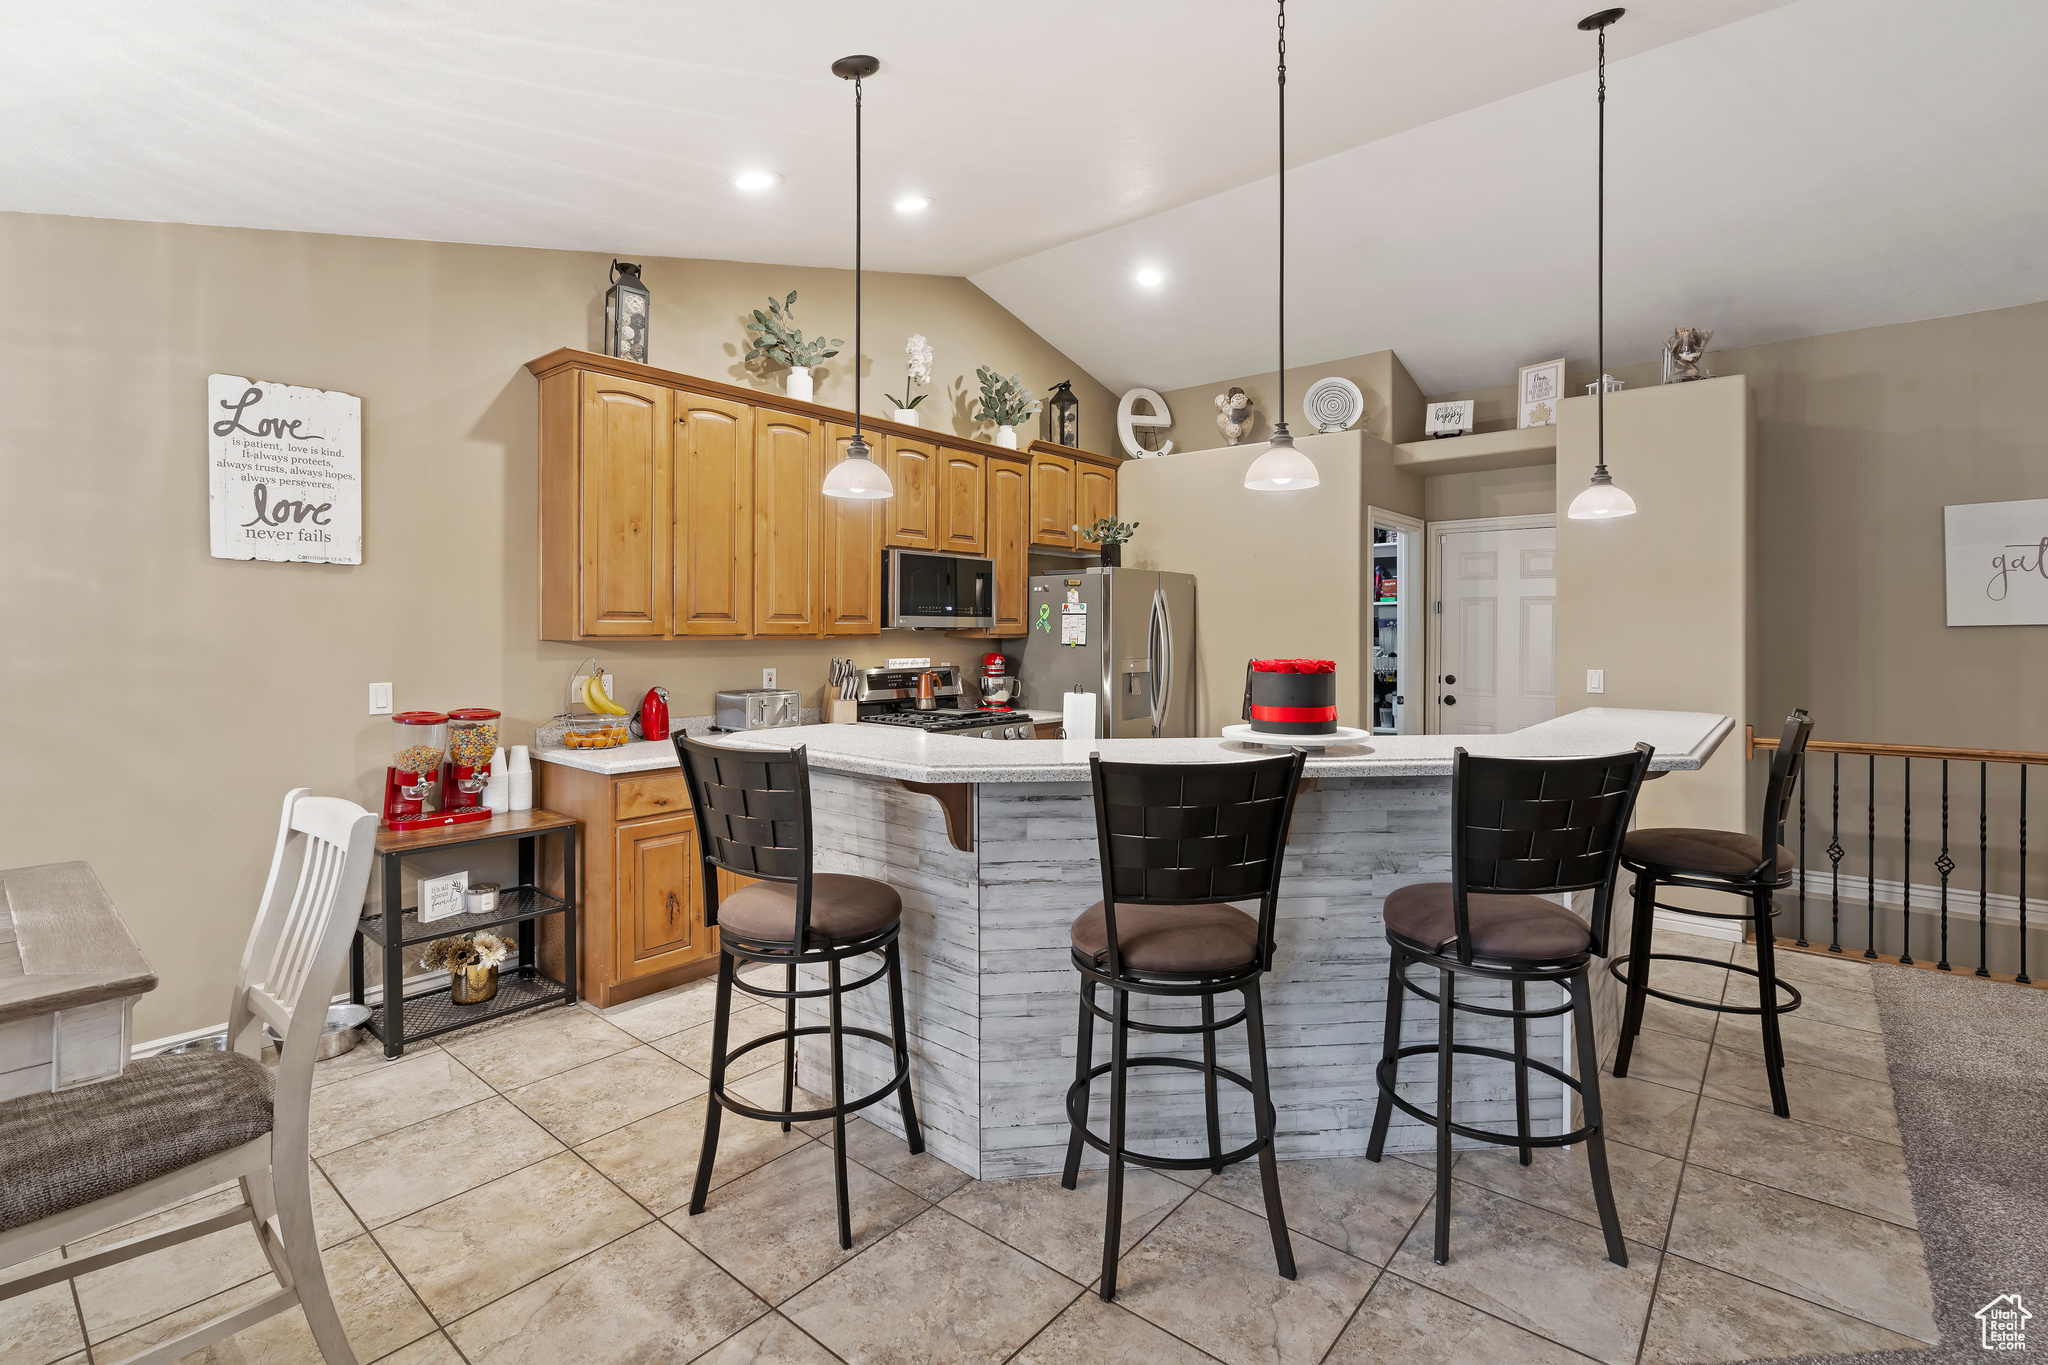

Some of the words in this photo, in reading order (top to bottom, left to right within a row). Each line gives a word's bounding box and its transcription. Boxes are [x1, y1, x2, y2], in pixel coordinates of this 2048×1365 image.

[213, 387, 325, 440] Love
[1435, 407, 1464, 424] happy
[1117, 388, 1174, 459] e
[232, 437, 240, 446] is
[243, 440, 283, 452] patient,
[288, 443, 308, 454] love
[311, 446, 318, 455] is
[321, 447, 345, 458] kind.
[242, 449, 250, 458] It
[253, 451, 288, 463] always
[291, 455, 334, 468] protects,
[216, 459, 252, 471] always
[255, 463, 287, 475] trusts,
[290, 466, 323, 478] always
[240, 473, 276, 485] always
[279, 479, 335, 490] perseveres.
[241, 483, 332, 527] love
[245, 528, 294, 540] never
[298, 528, 332, 543] fails
[431, 891, 448, 900] about
[431, 890, 458, 912] family
